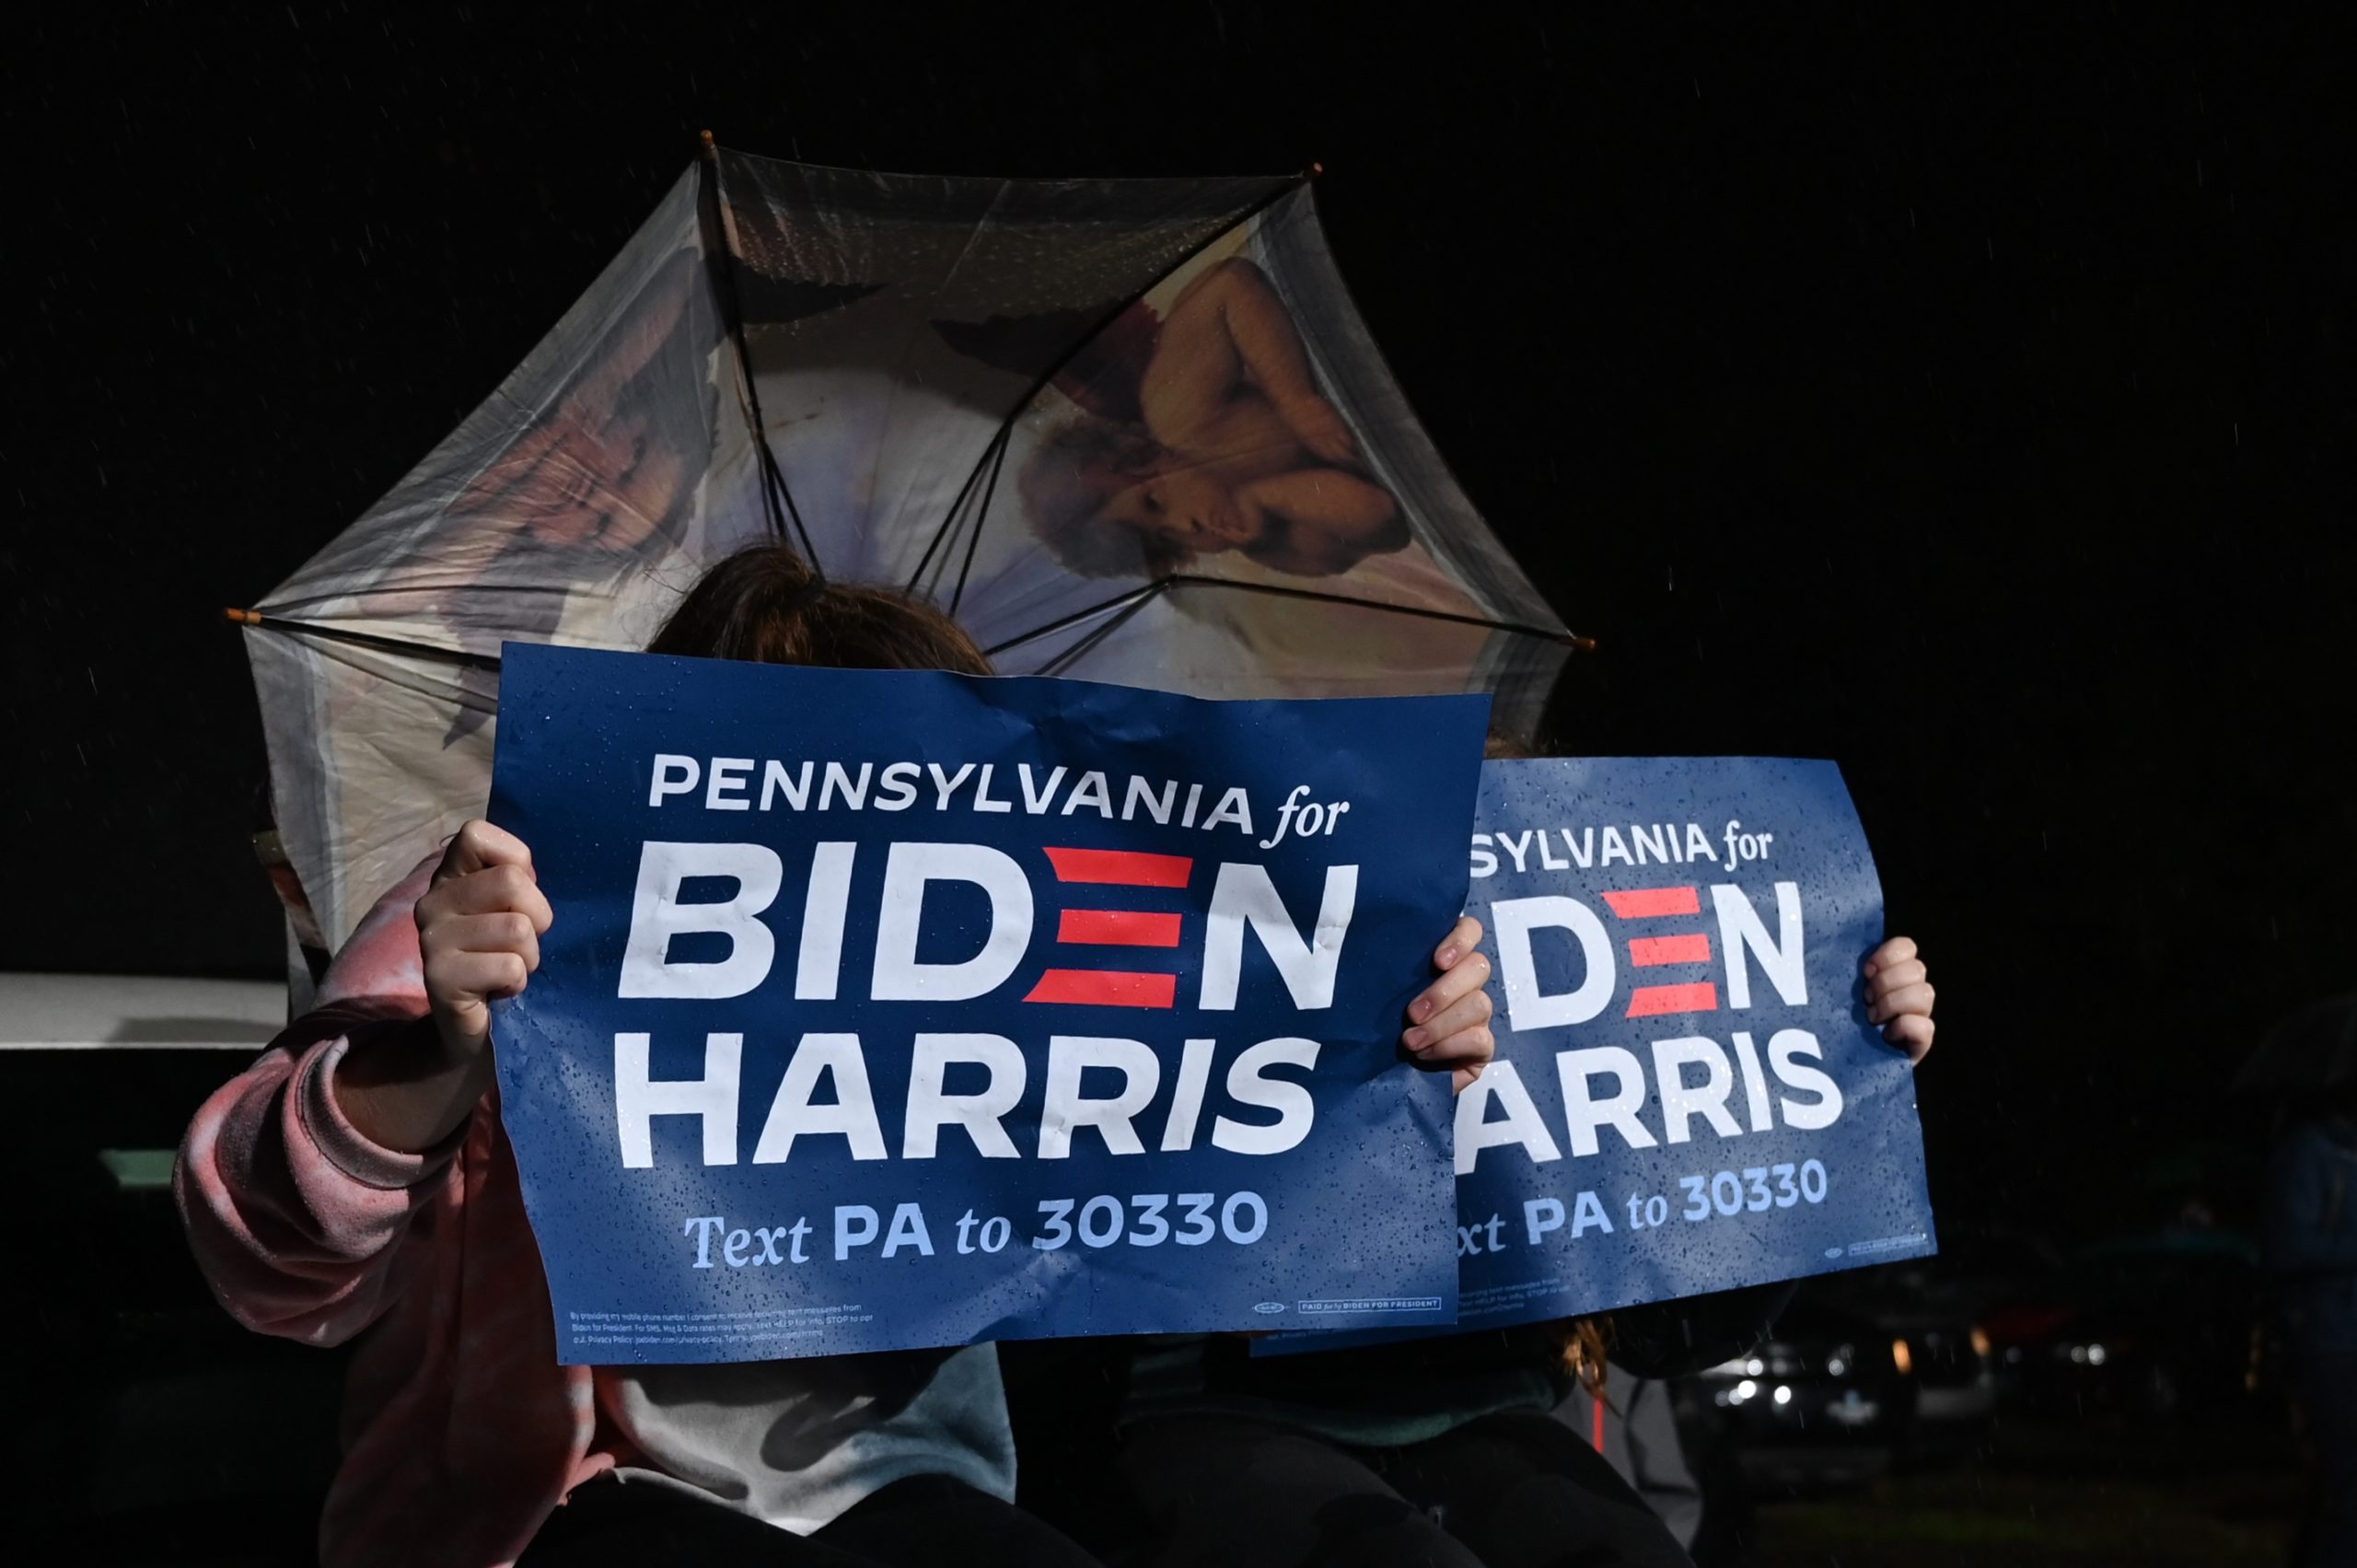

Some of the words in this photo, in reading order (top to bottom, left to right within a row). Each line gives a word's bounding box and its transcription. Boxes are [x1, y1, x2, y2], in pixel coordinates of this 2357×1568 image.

[650, 753, 1253, 835] PENNSYLVANIA
[1259, 784, 1350, 849] for
[1469, 823, 1718, 878] SYLVANIA
[1723, 819, 1773, 872] for
[618, 842, 1359, 1011] BIDEN
[1488, 879, 1809, 1033] DEN
[614, 1032, 1321, 1169] HARRIS
[1453, 1028, 1844, 1176] ARRIS
[684, 1214, 814, 1269] Text
[834, 1202, 935, 1260] PA
[956, 1208, 1011, 1254] to
[1032, 1191, 1268, 1249] 30330
[1457, 1212, 1507, 1258] xt
[1524, 1191, 1614, 1246] PA
[1626, 1191, 1668, 1230] to
[1678, 1158, 1827, 1222] 30330
[1342, 1301, 1370, 1309] BIDEN
[1389, 1299, 1438, 1308] PRESIDENT
